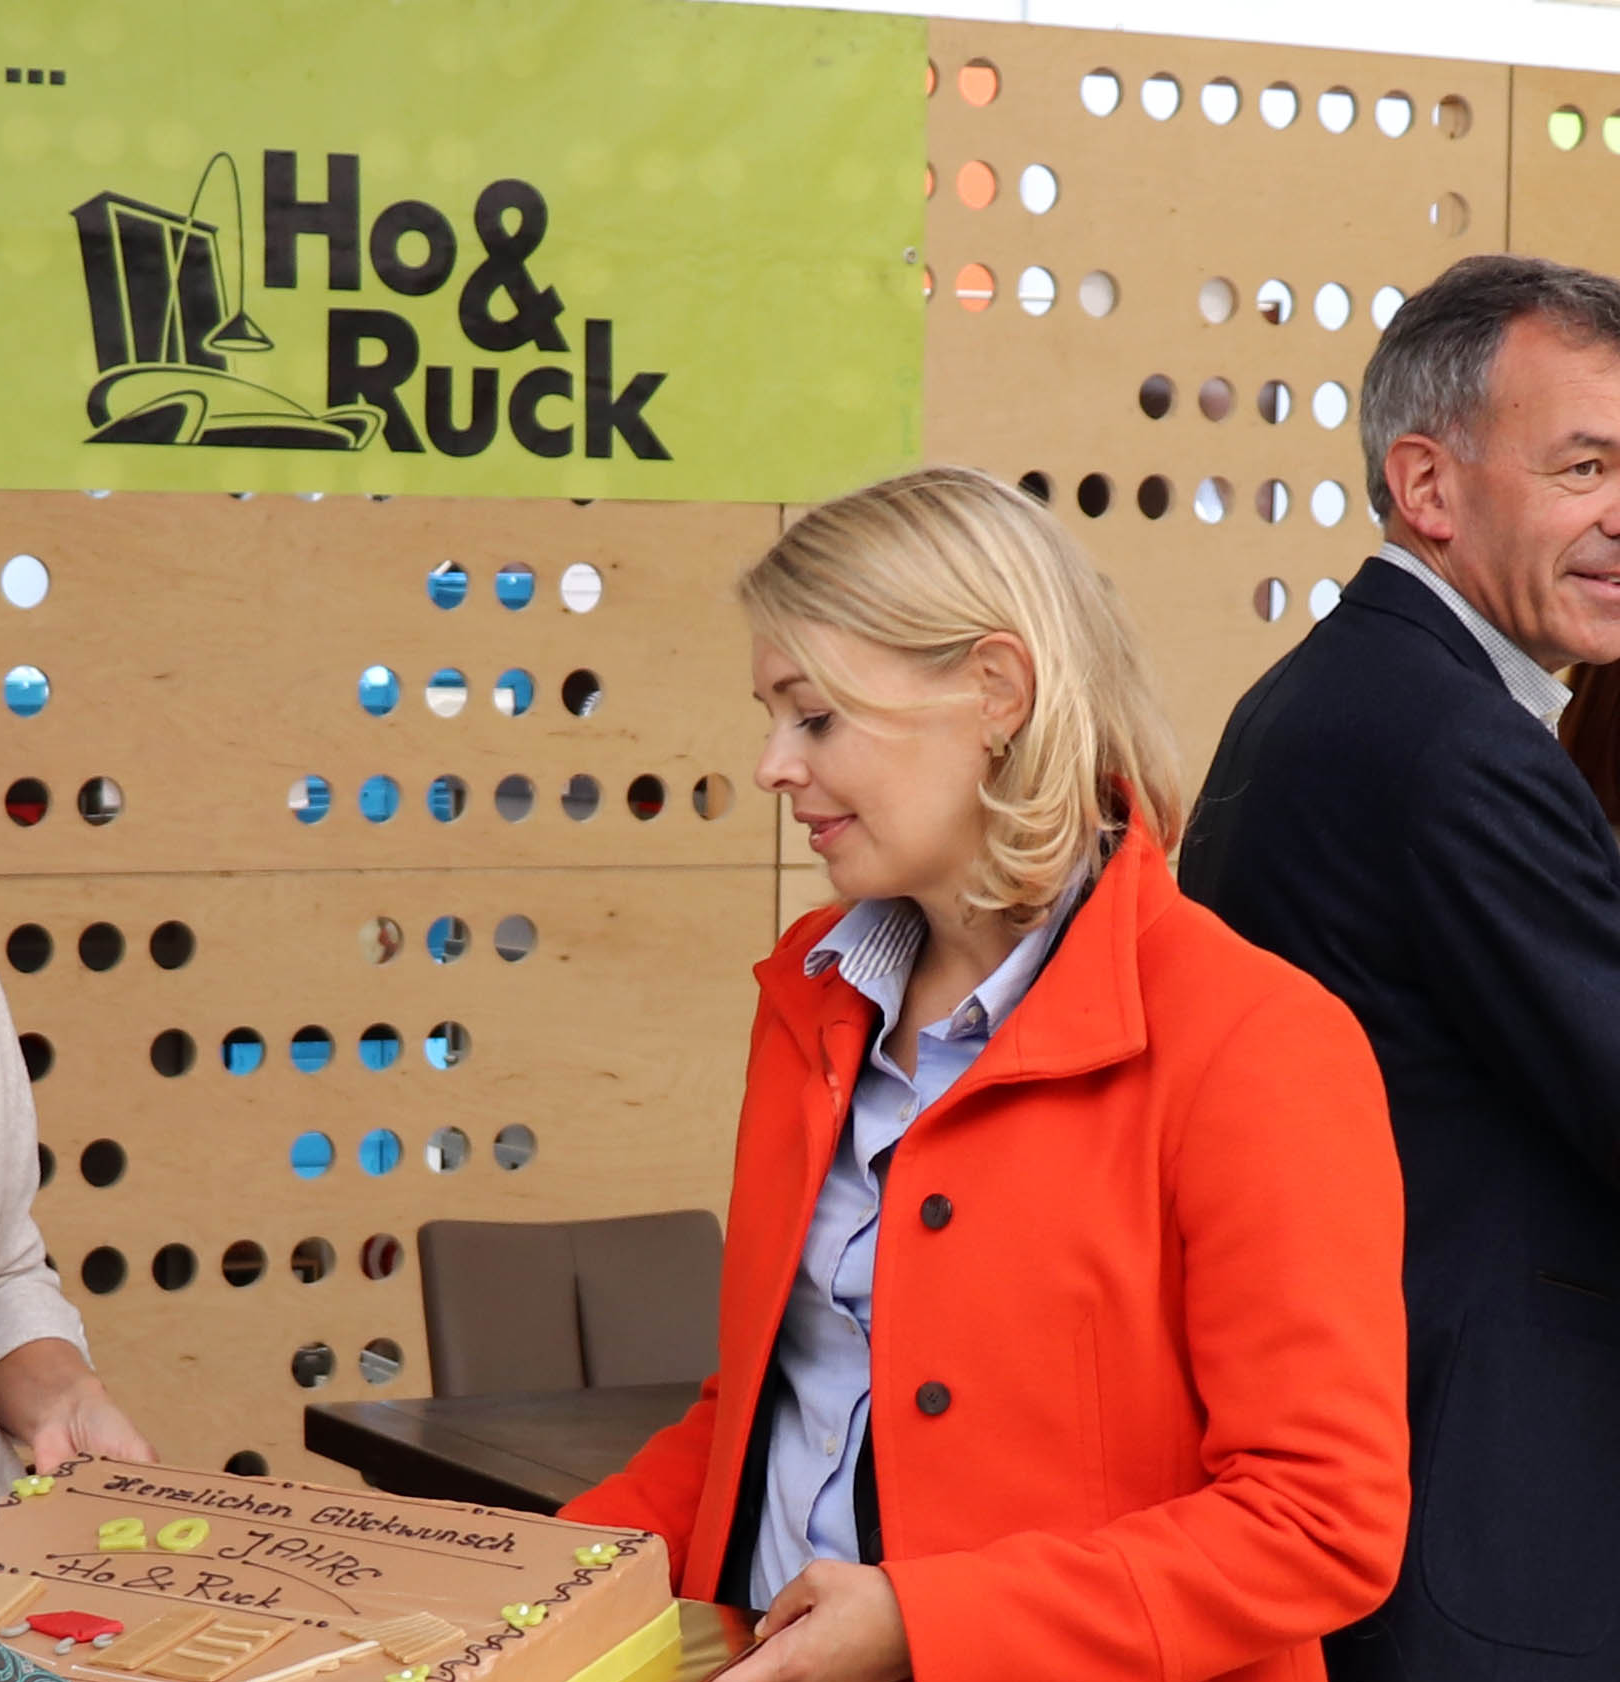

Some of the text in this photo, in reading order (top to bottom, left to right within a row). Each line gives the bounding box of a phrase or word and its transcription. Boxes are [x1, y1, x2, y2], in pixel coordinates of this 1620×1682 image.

[327, 308, 674, 461] Ruck
[103, 1474, 516, 1553] Herzlichen Glückwunsch
[57, 1557, 282, 1610] Ho & Ruck
[217, 1530, 383, 1587] JAHRE
